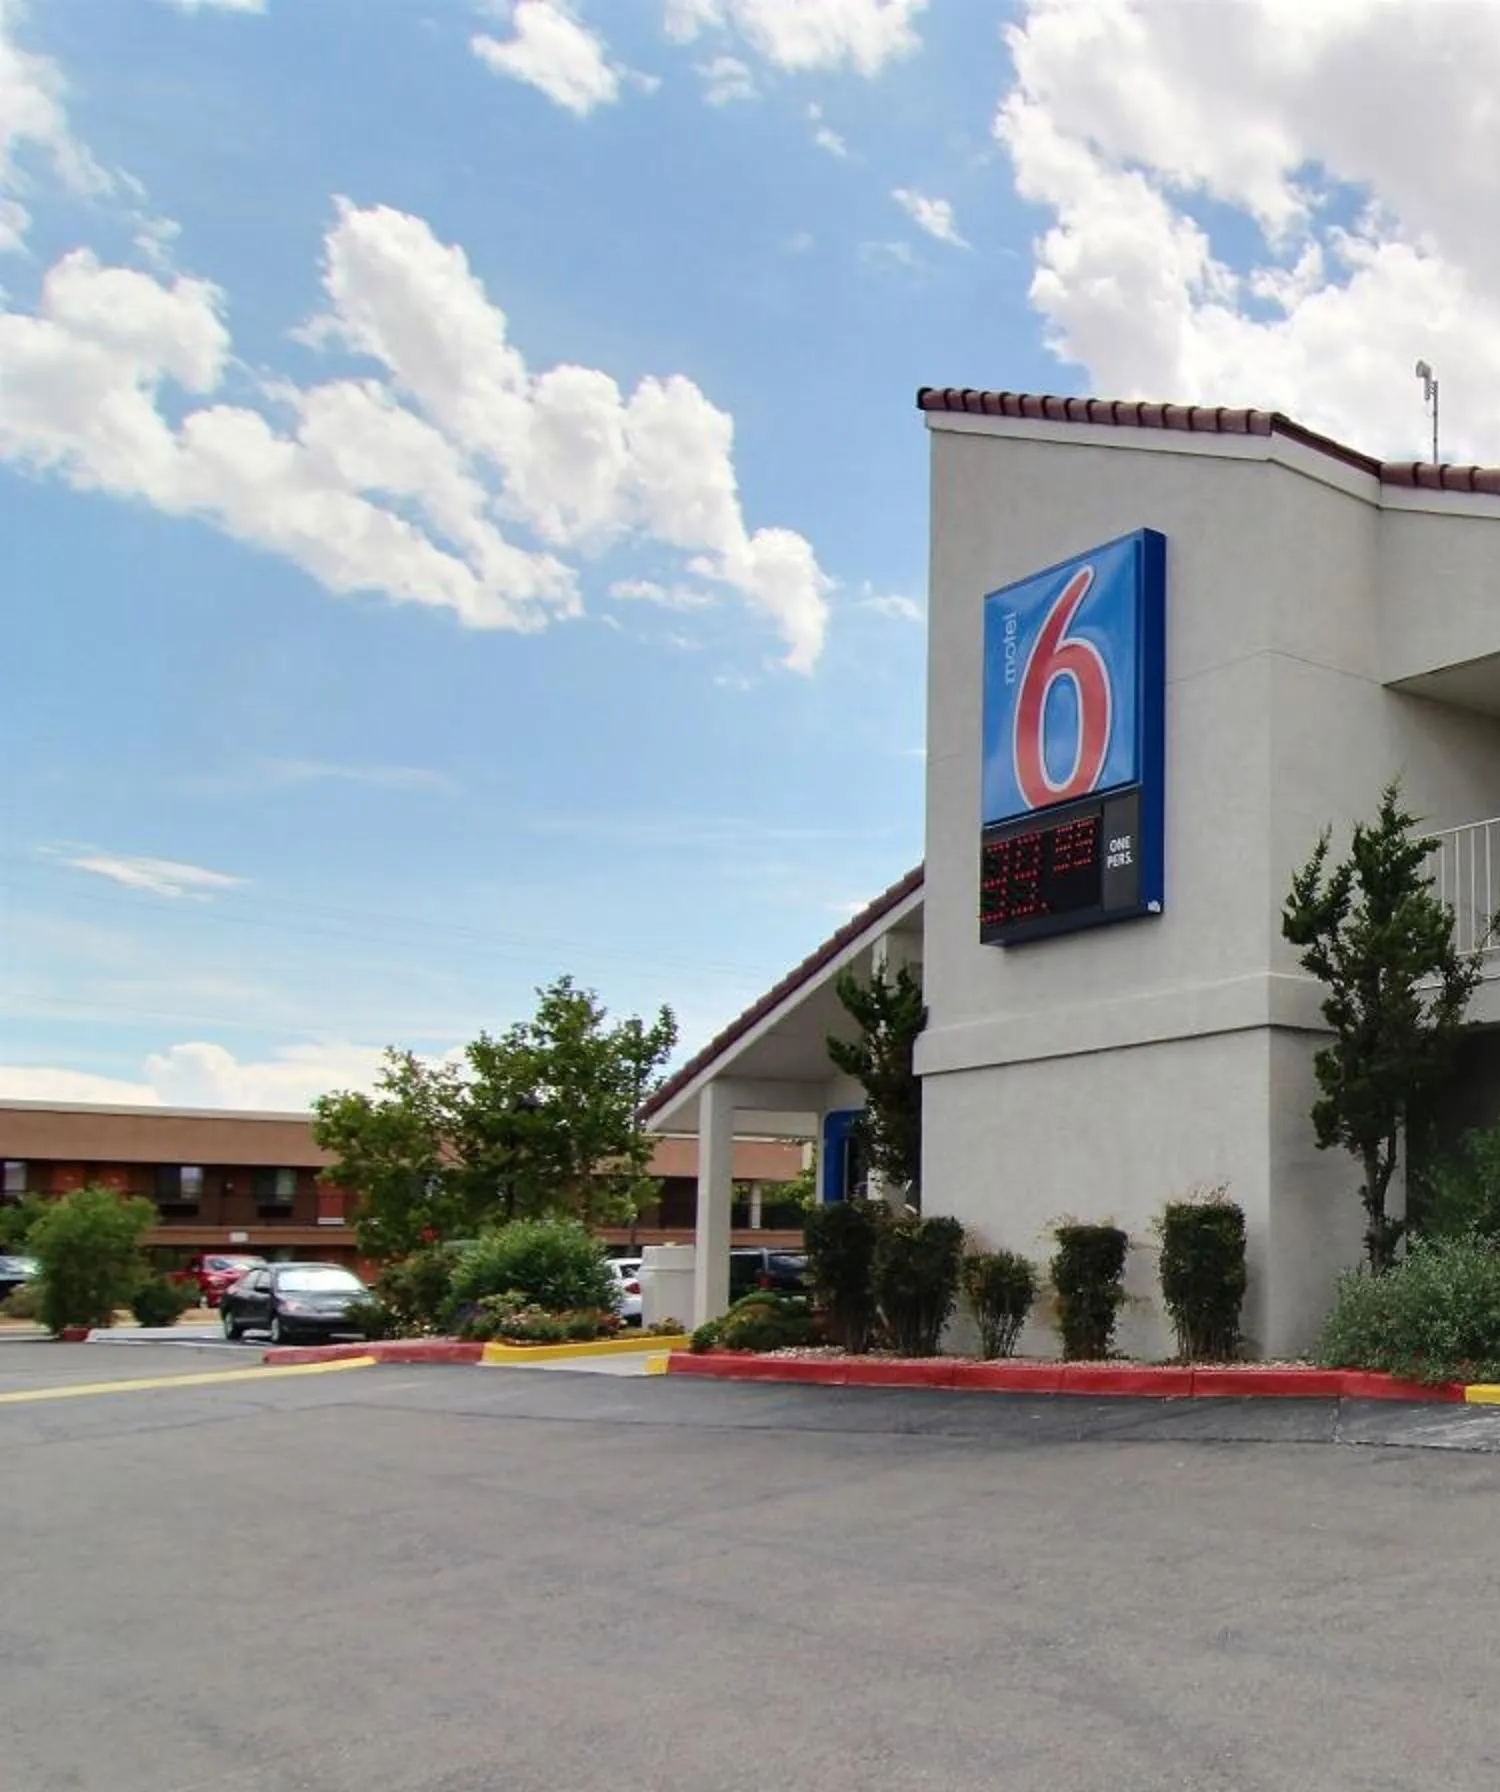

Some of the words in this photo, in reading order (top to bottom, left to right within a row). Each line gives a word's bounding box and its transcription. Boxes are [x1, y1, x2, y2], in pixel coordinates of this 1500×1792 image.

[1003, 611, 1017, 686] motel
[1013, 564, 1112, 810] 6
[1107, 851, 1133, 869] PERS.
[1109, 835, 1131, 853] ONE
